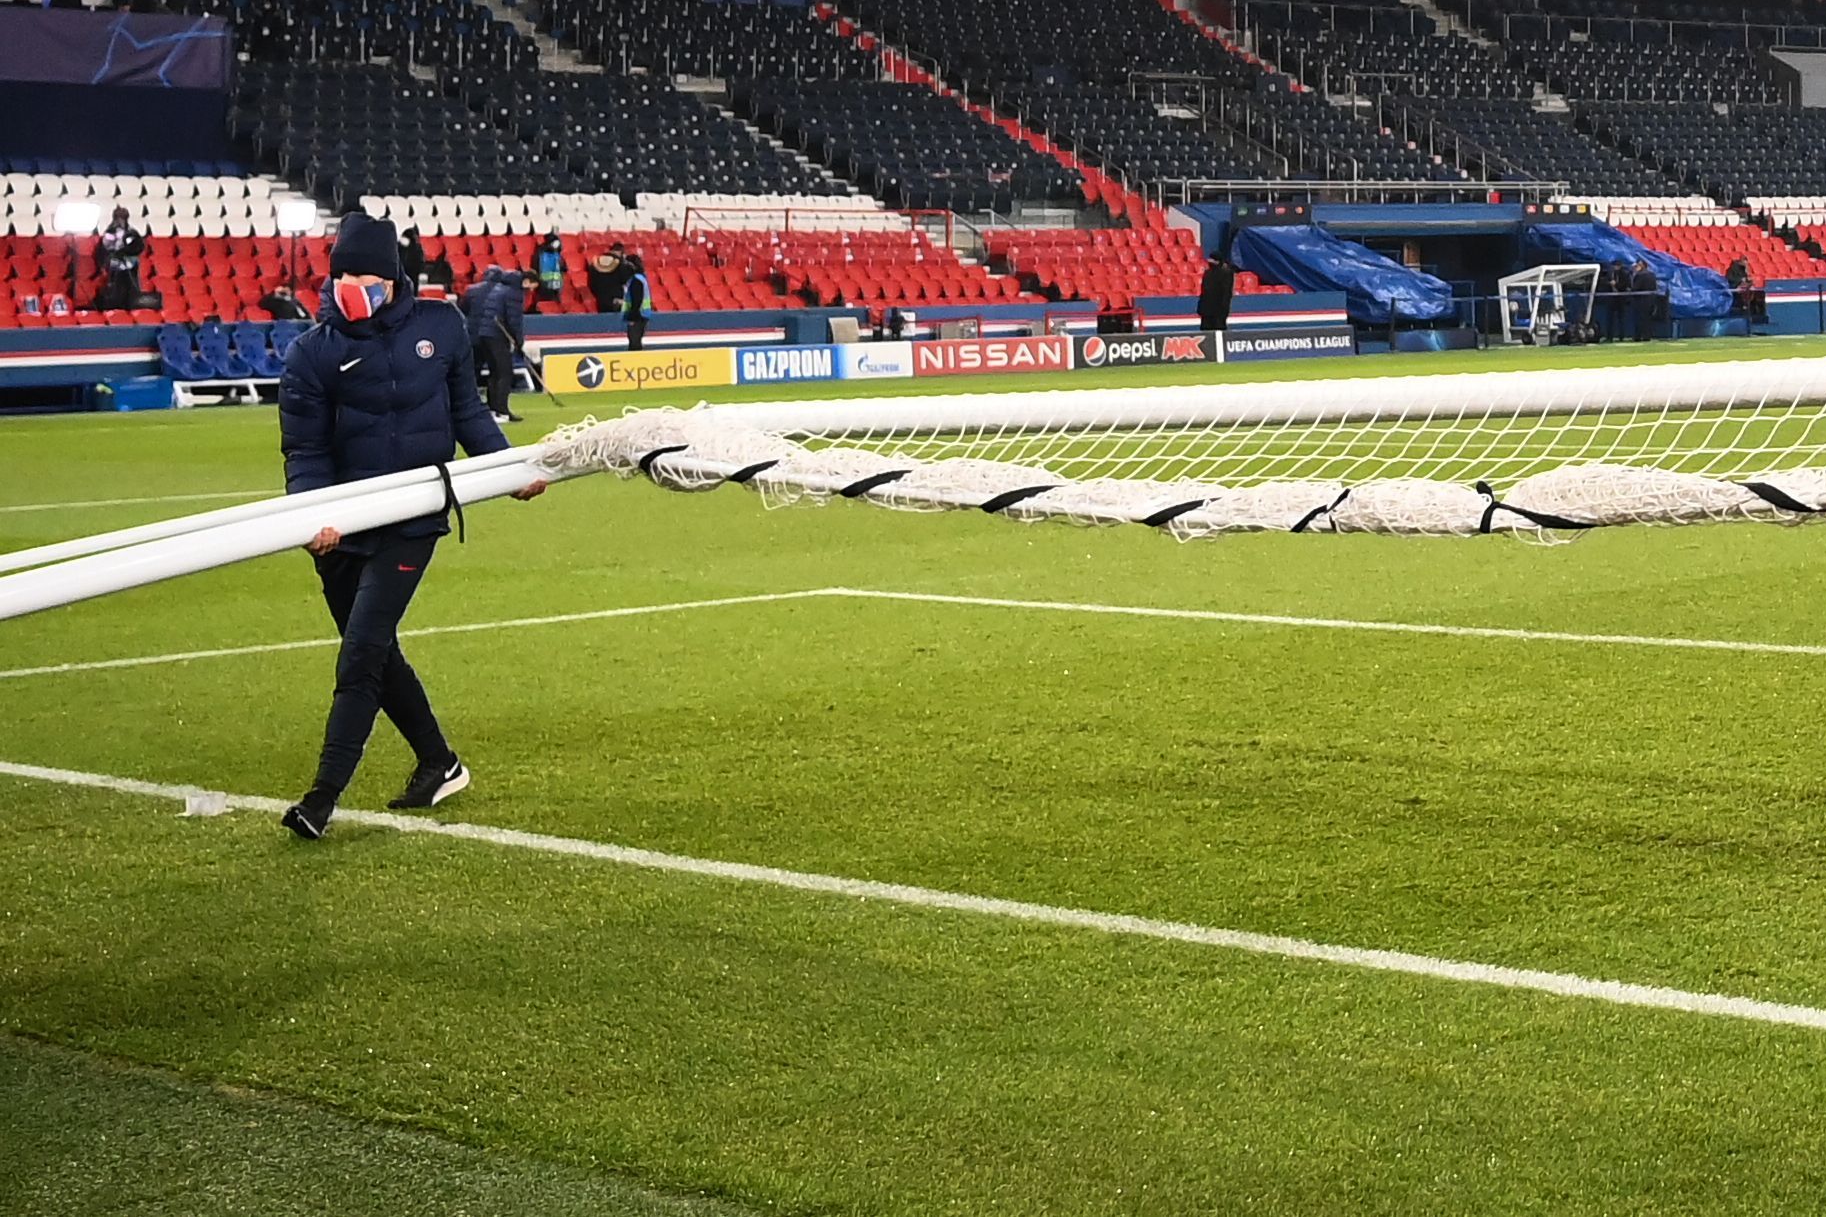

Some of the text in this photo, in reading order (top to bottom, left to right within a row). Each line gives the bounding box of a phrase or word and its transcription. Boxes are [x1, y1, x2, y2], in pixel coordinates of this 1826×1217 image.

[919, 340, 1062, 371] NISSAN
[1109, 337, 1158, 365] pepsi
[1226, 335, 1351, 353] UEFA CHAMPIONS LEAGUE
[609, 357, 698, 389] Expedia
[742, 349, 832, 380] GAZPROM
